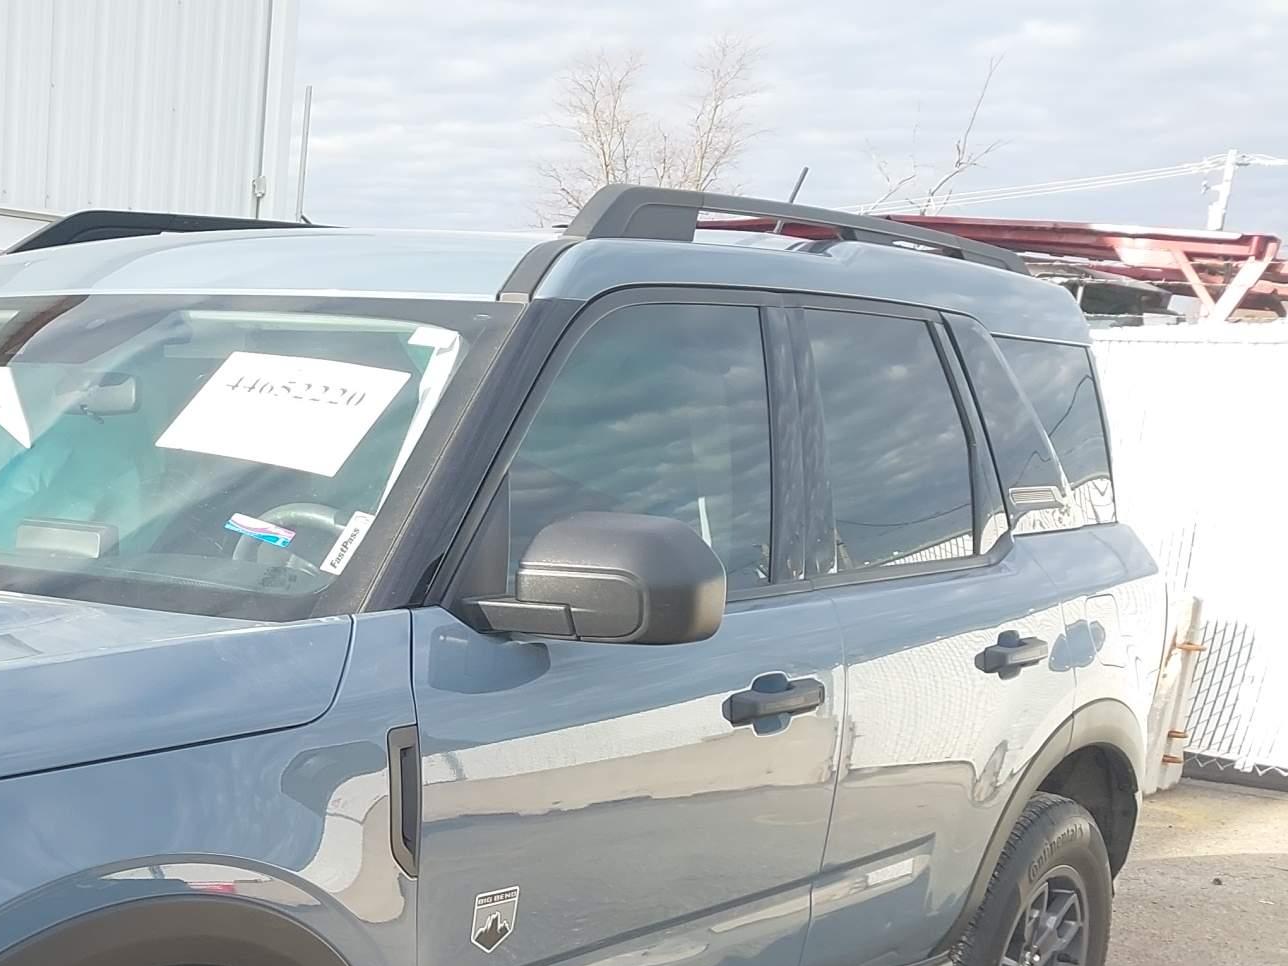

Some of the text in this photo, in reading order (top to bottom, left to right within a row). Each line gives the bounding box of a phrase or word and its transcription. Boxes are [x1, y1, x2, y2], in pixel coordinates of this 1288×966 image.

[225, 376, 367, 407] 44652220
[329, 527, 360, 569] FastPass
[478, 891, 517, 905] BIG BEND
